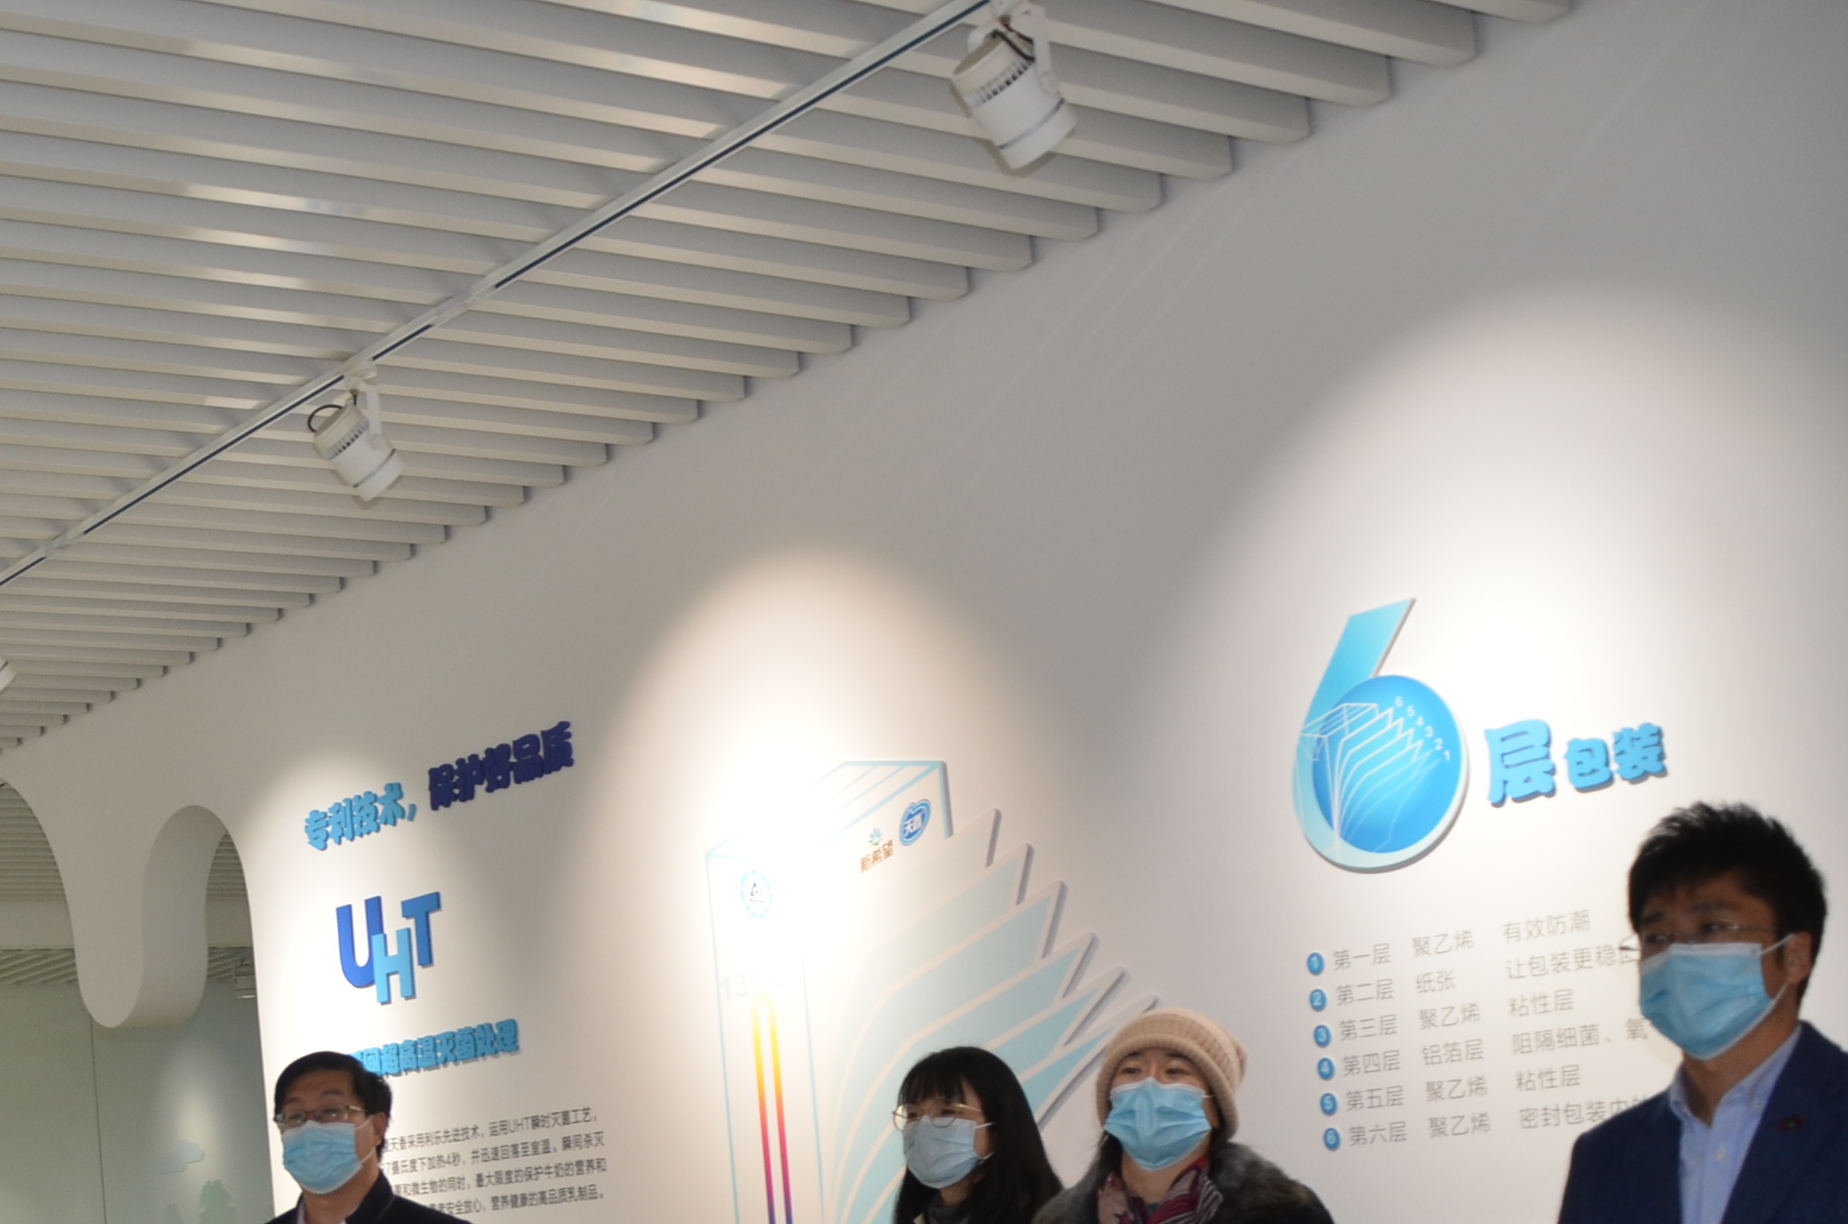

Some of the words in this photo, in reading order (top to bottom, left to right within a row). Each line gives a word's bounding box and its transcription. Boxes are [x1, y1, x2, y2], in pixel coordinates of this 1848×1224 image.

[1292, 597, 1468, 872] 6
[1484, 719, 1668, 807] 层包装
[336, 891, 441, 1005] UHT
[1333, 942, 1391, 971] 第一层
[1412, 929, 1474, 958] 聚乙烯
[1503, 909, 1591, 943] 有效防潮
[1336, 978, 1394, 1007] 第二层
[1415, 969, 1456, 994] 纸张
[1339, 1014, 1397, 1042] 第三层
[1419, 1001, 1481, 1031] 聚乙烯
[1508, 988, 1575, 1018] 粘性层
[347, 1018, 520, 1078] 间超高温灭菌处理
[1343, 1050, 1400, 1077] 第四层
[1422, 1038, 1484, 1067] 铝箔层
[1346, 1085, 1404, 1112] 第五层
[1425, 1075, 1488, 1103] 聚乙烯
[1515, 1064, 1581, 1092] 粘性层
[1349, 1120, 1407, 1147] 第六层
[1428, 1111, 1491, 1139] 聚乙烯
[1519, 1095, 1648, 1129] 密封包装内
